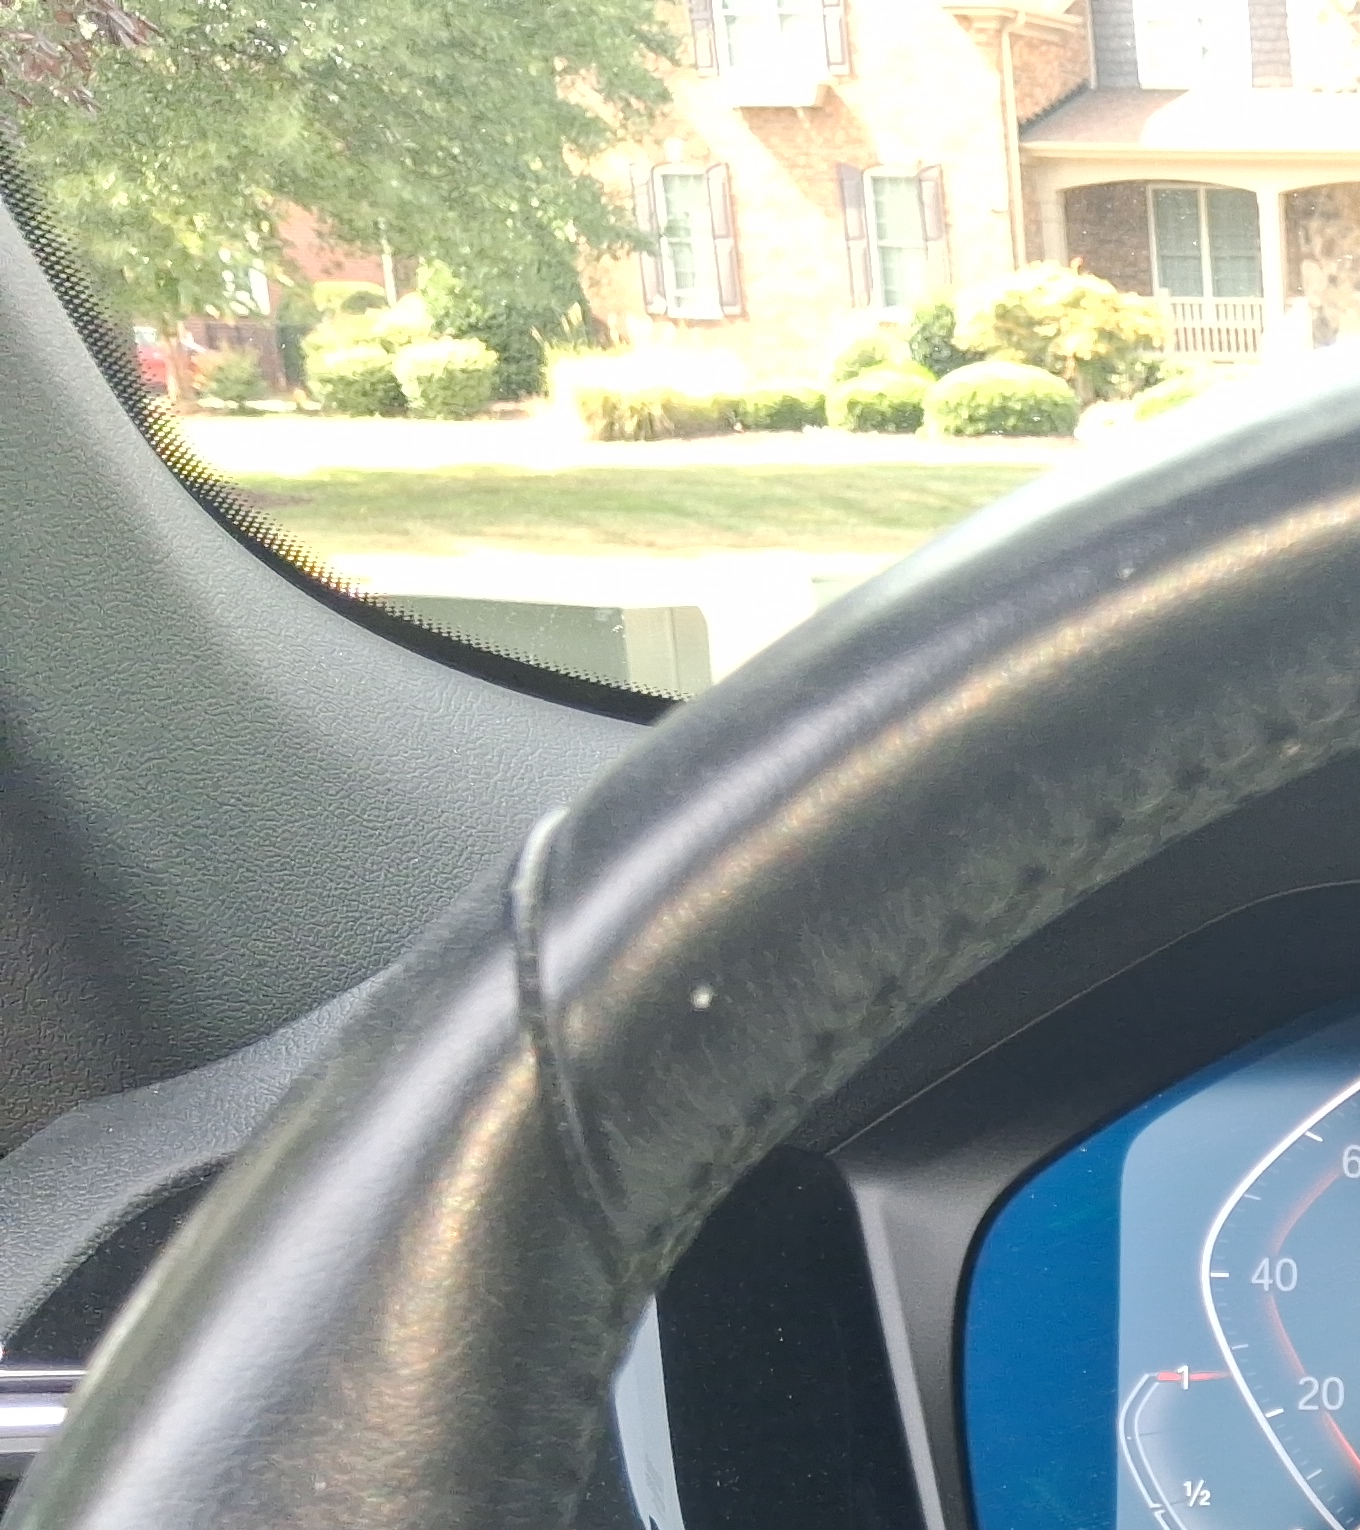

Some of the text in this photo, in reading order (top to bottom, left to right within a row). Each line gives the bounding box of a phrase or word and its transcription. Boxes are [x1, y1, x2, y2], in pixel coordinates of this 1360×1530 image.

[1251, 1257, 1299, 1292] 40
[1176, 1365, 1191, 1391] 1
[1298, 1376, 1345, 1410] 20
